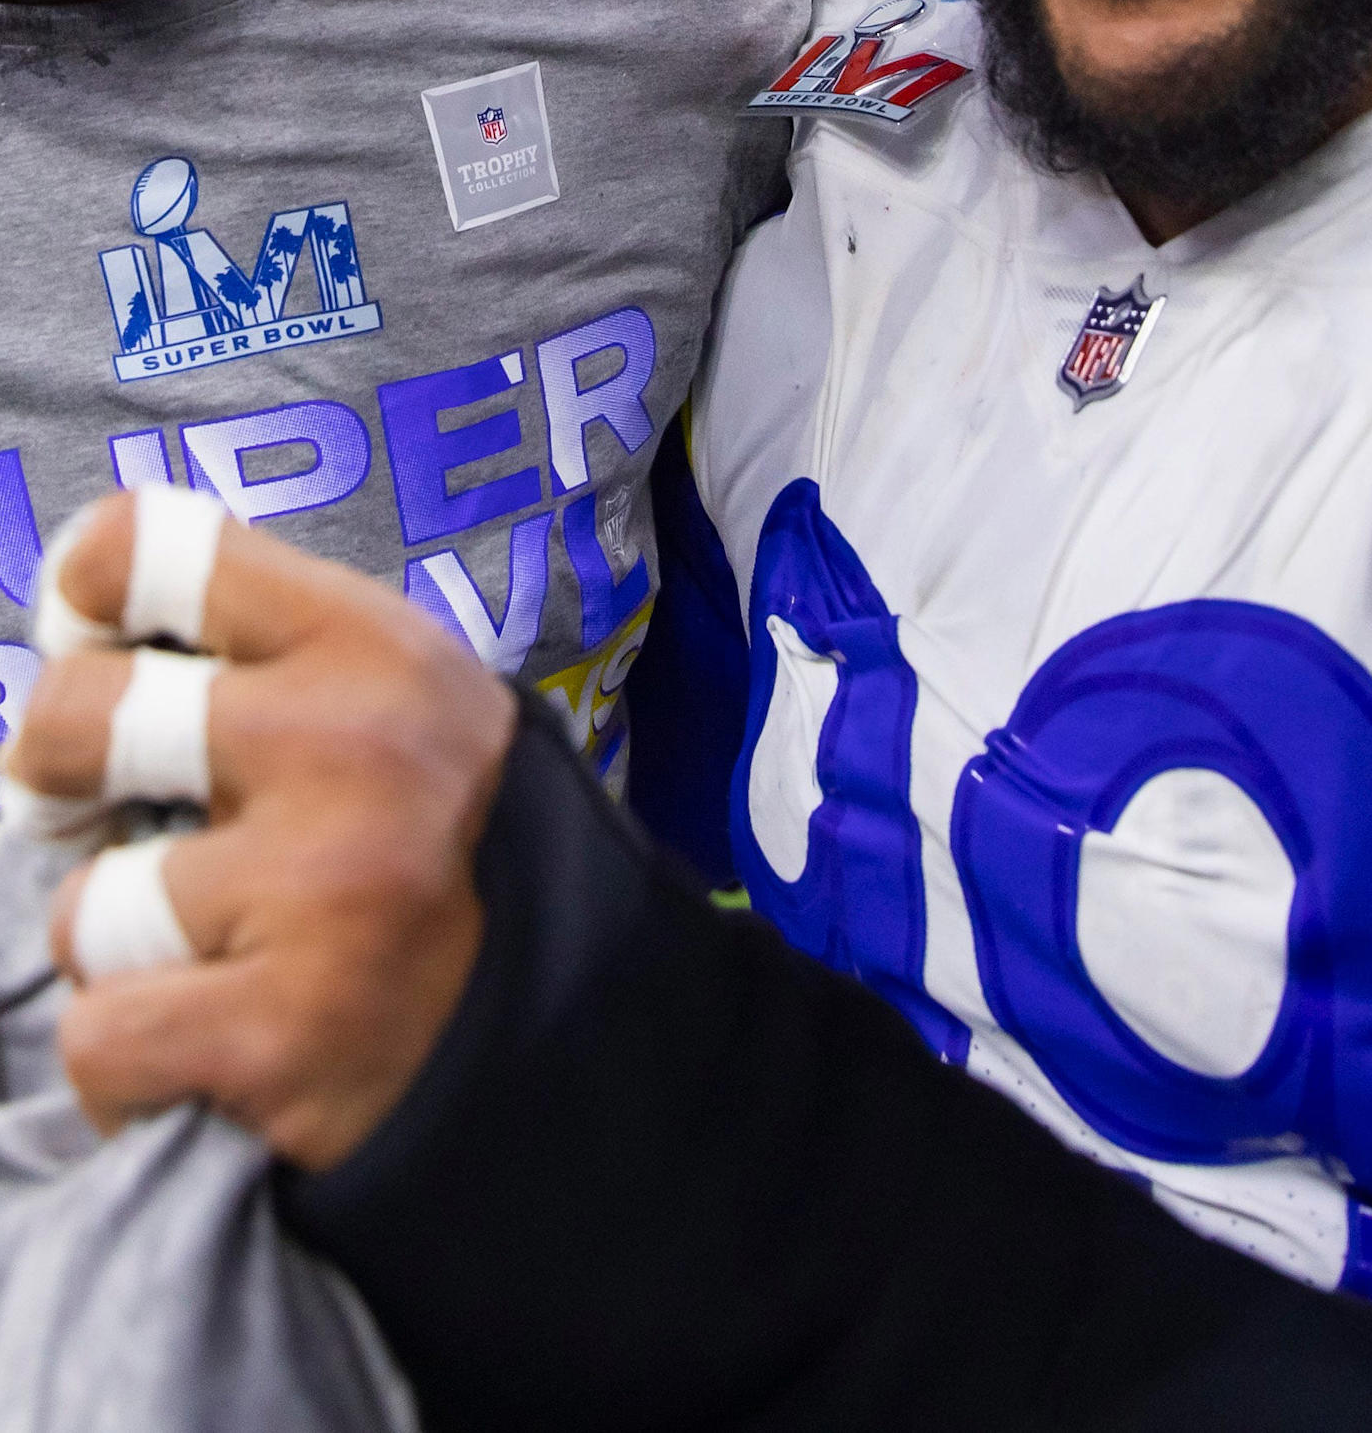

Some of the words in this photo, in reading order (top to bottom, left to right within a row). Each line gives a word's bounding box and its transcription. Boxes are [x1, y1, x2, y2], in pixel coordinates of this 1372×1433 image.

[764, 93, 826, 105] SUPER
[831, 96, 887, 113] BOWL
[457, 144, 538, 184] TROPHY
[468, 166, 536, 194] COLLECTION
[142, 334, 252, 371] SUPER
[263, 314, 356, 344] BOWL
